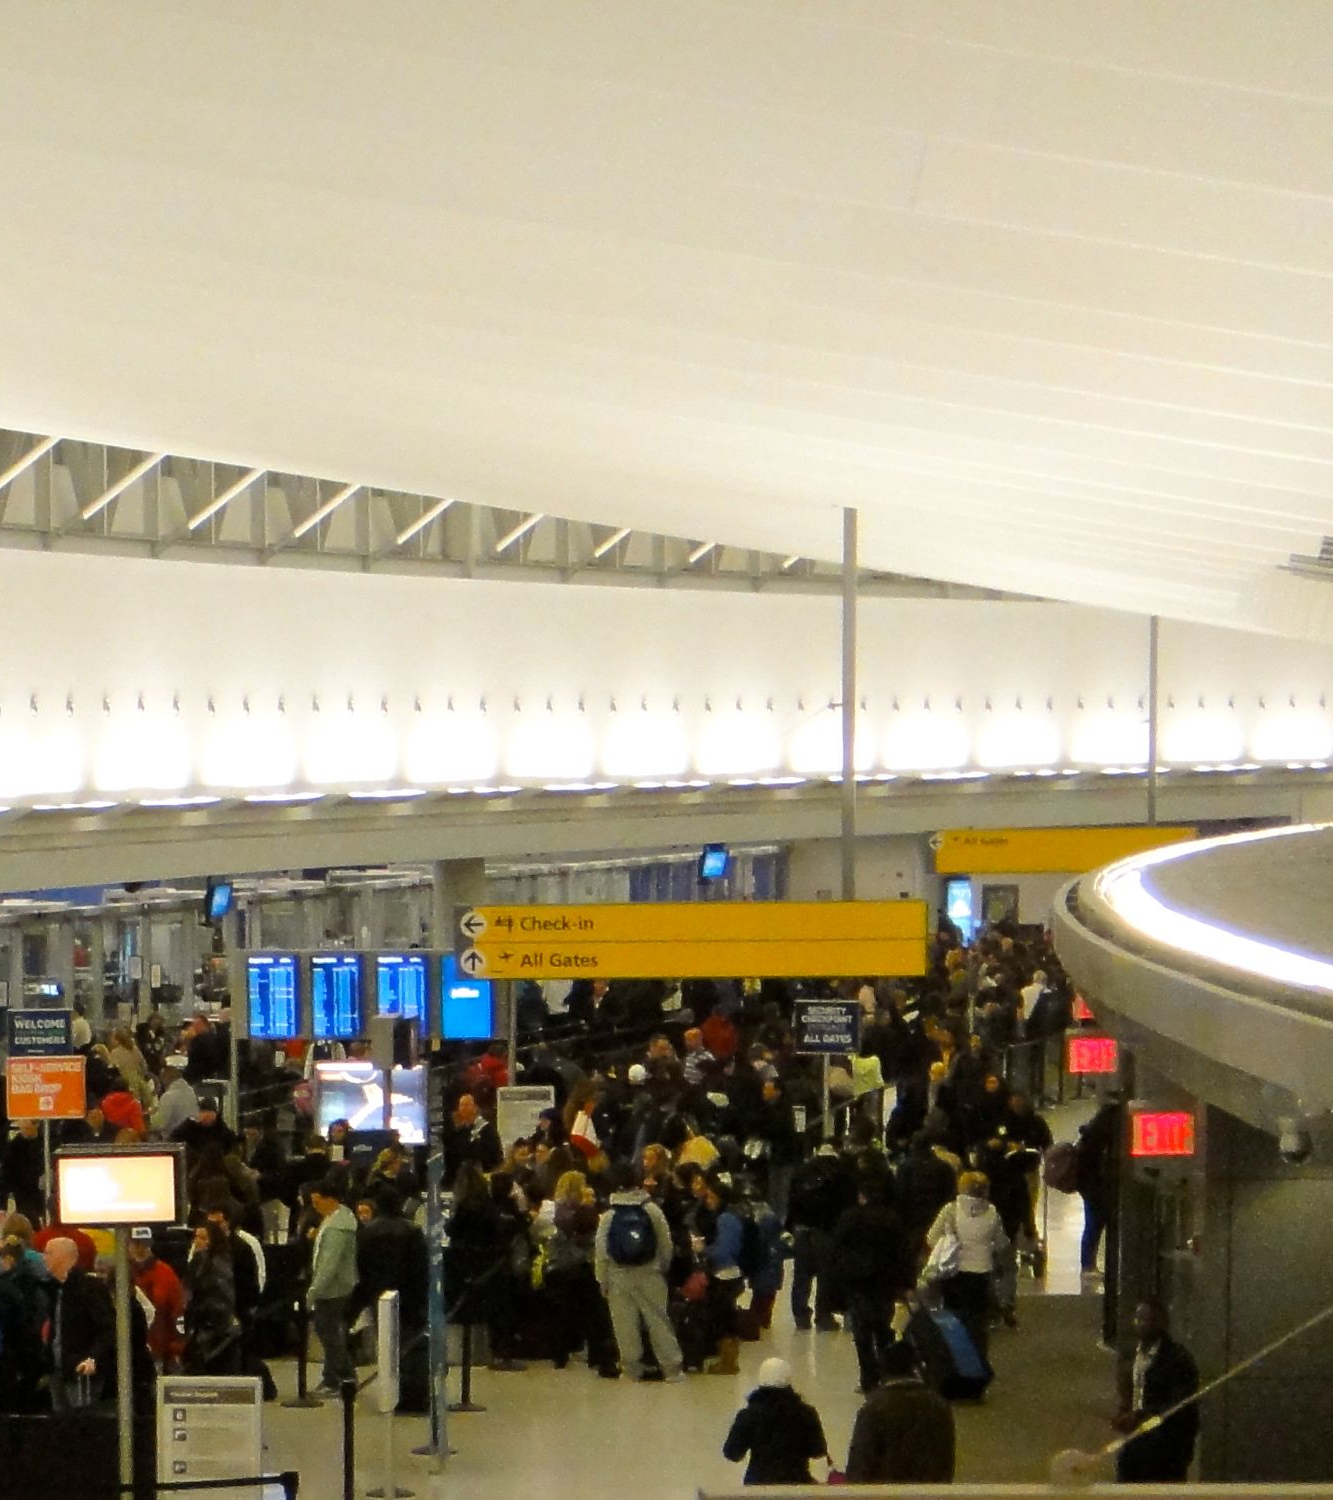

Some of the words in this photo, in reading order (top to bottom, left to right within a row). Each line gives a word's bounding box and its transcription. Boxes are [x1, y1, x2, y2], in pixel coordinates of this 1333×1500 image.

[519, 916, 595, 931] Check-in
[520, 953, 544, 967] All
[549, 953, 598, 967] Gates
[14, 1019, 66, 1029] WELCOME
